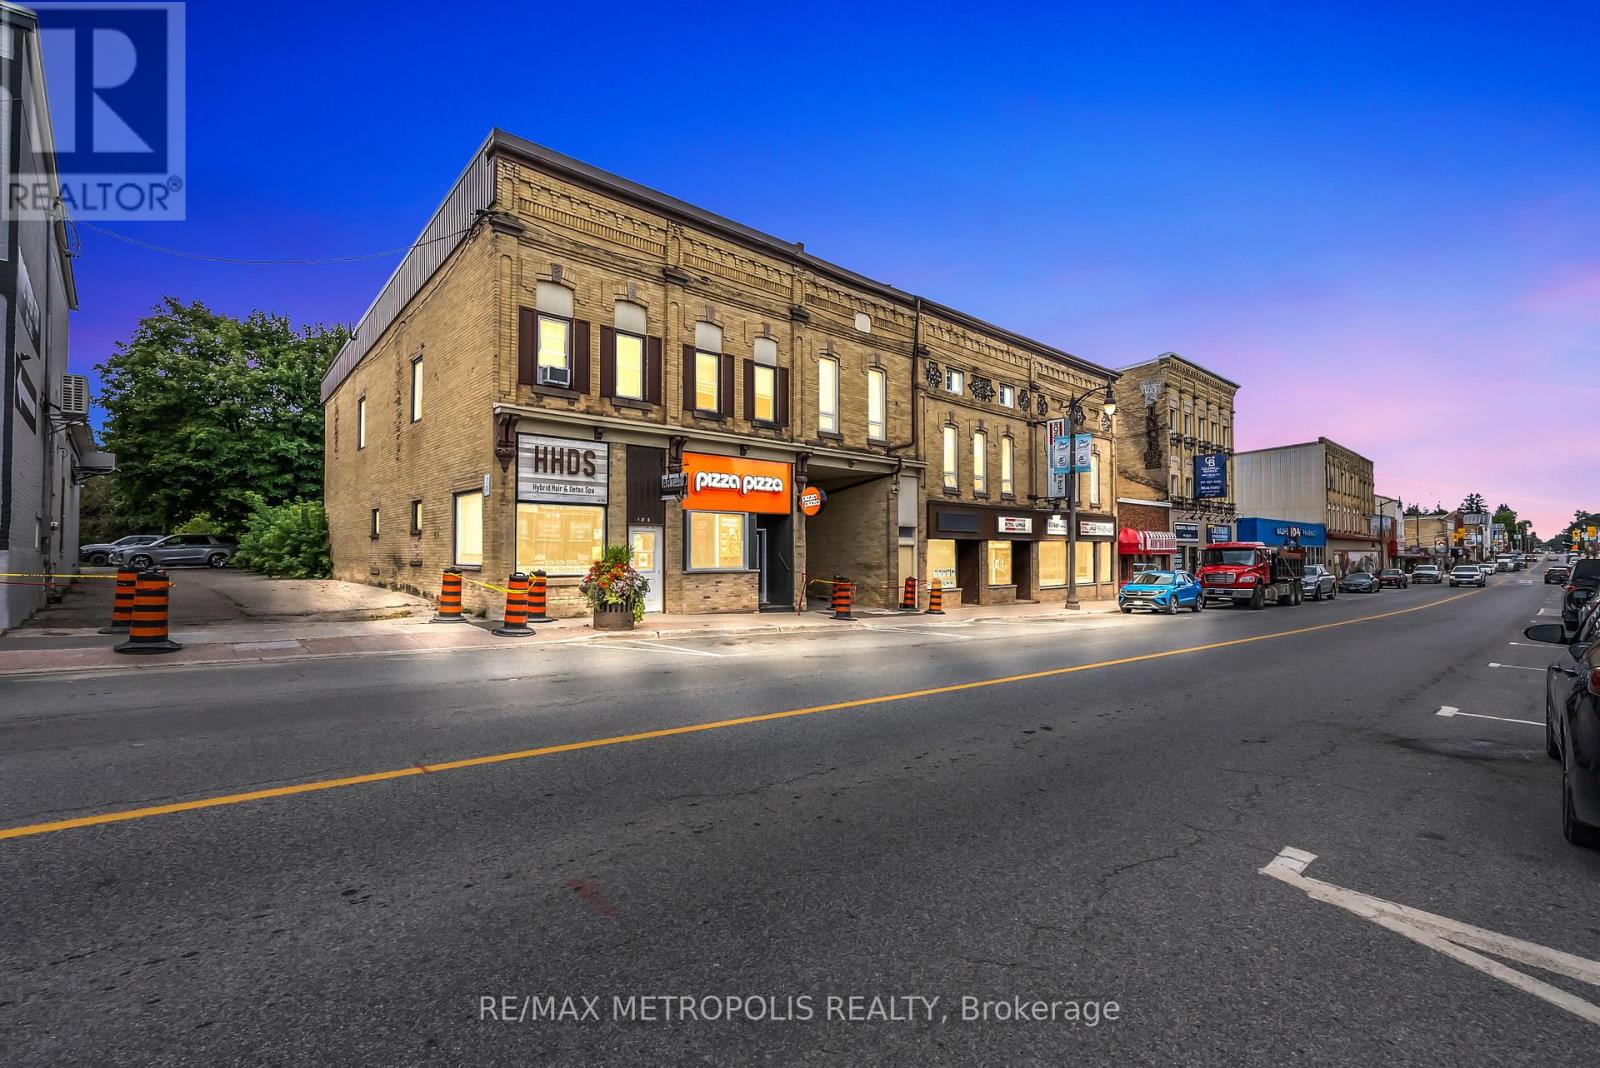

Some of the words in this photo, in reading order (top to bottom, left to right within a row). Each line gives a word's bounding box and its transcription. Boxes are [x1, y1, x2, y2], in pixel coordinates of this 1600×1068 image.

[534, 445, 596, 477] HHDS
[532, 483, 550, 492] Hybrid
[569, 485, 584, 493] Detox
[585, 486, 594, 494] Spa
[695, 471, 740, 492] pizza
[742, 475, 783, 495] pizza
